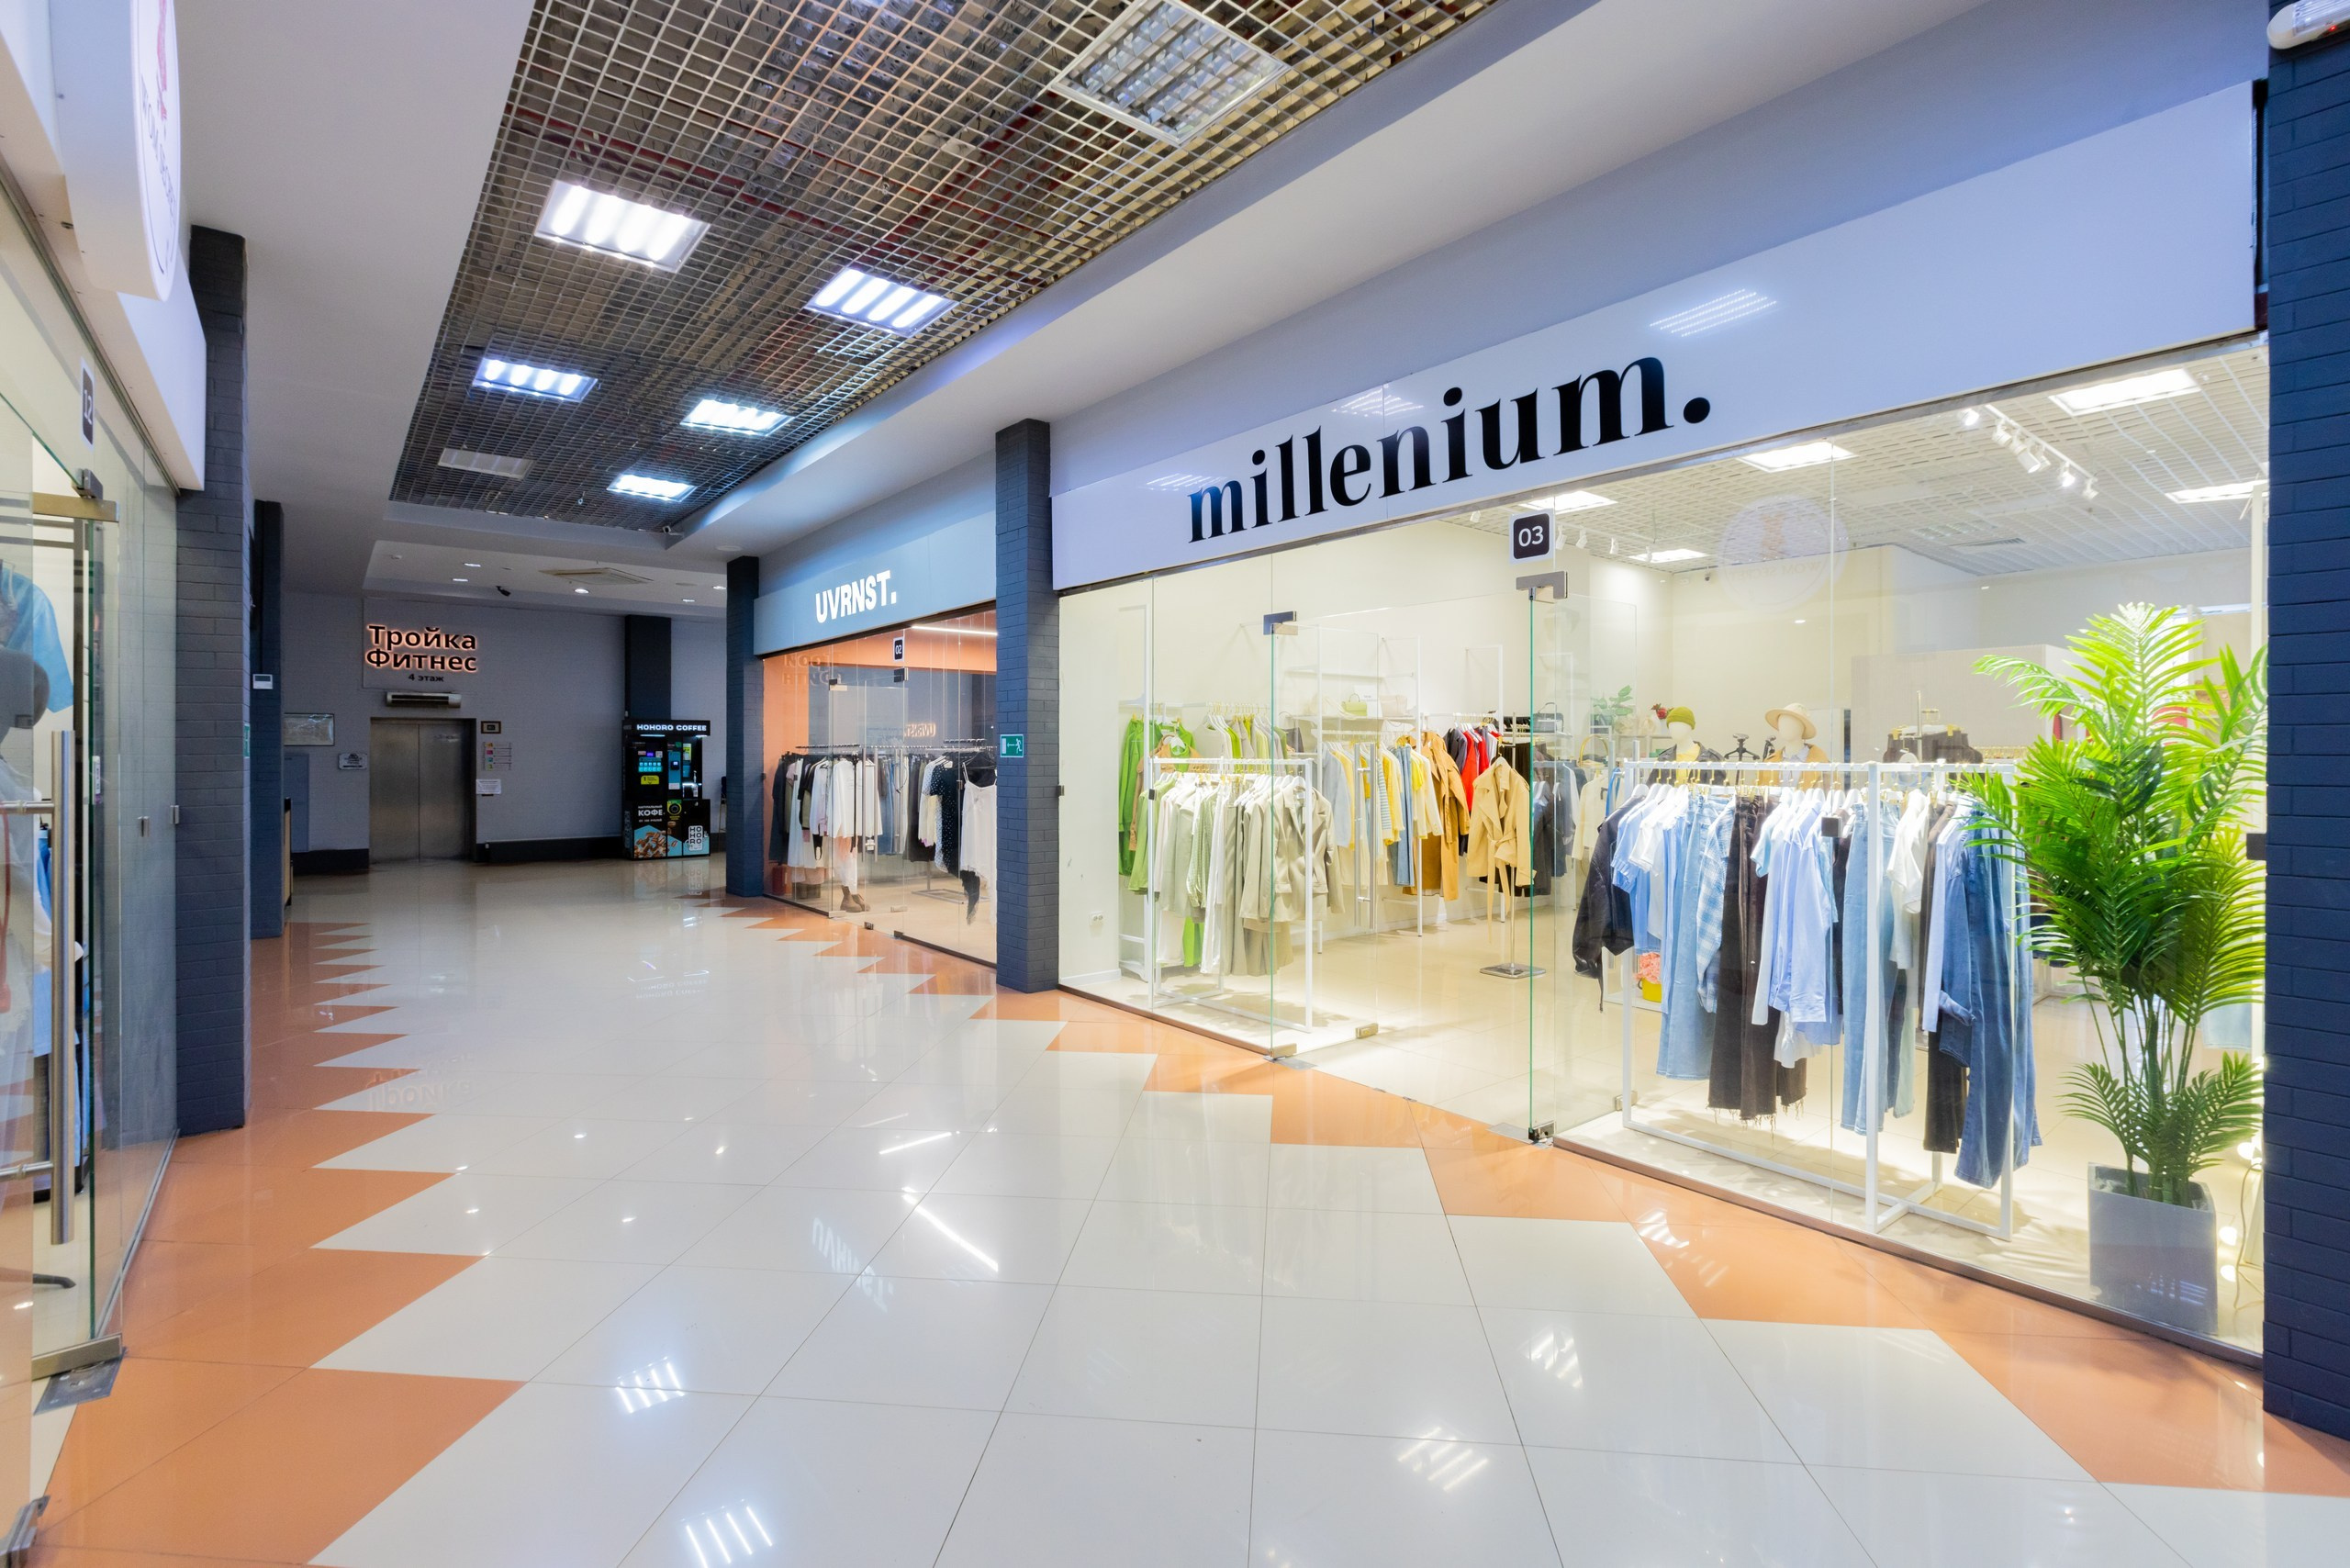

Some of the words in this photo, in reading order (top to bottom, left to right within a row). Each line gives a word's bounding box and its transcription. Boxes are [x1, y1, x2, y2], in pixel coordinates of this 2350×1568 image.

[84, 388, 93, 426] 12
[1188, 356, 1710, 543] millenium.
[1518, 525, 1544, 547] 03
[815, 569, 897, 623] UVRNST.
[368, 625, 476, 651] Тройка
[895, 644, 902, 655] 02
[366, 648, 477, 671] Фитнес
